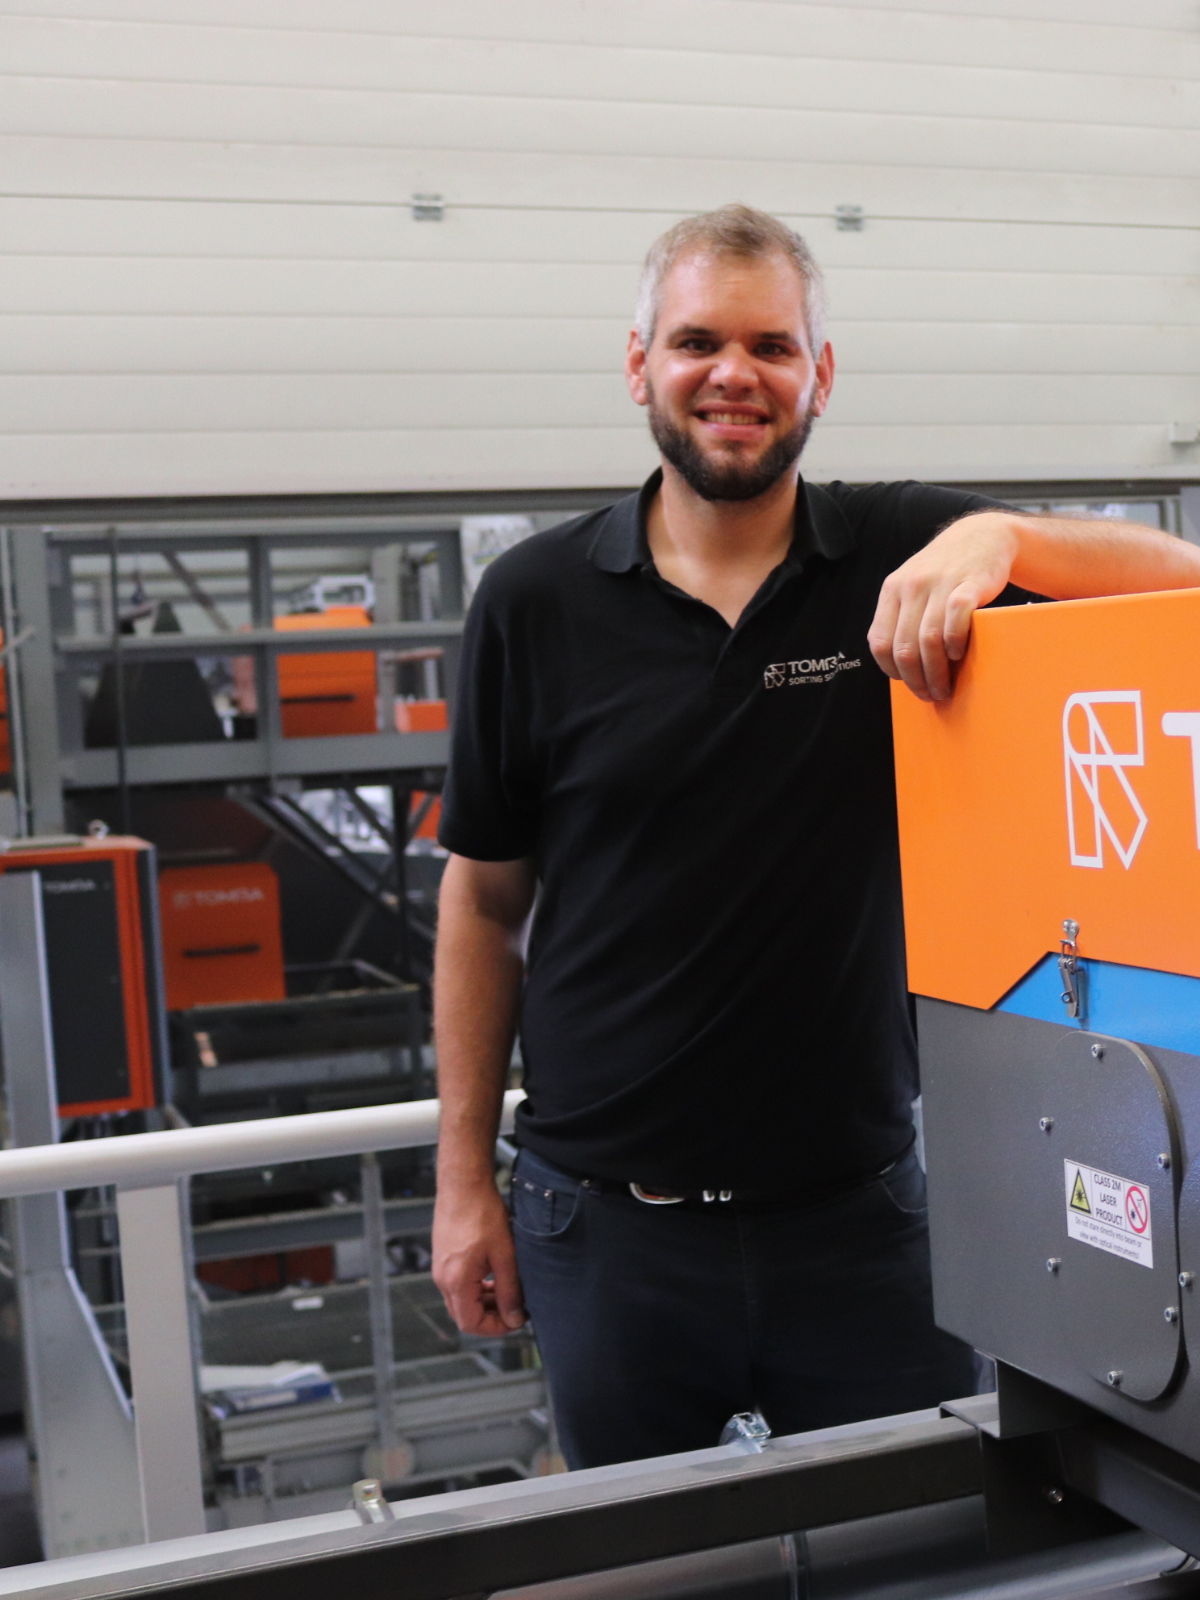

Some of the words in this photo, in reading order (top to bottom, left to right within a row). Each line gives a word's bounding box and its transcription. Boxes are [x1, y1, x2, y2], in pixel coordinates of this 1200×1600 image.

[1094, 1174, 1111, 1188] CLASS
[1100, 1192, 1117, 1208] LASER
[1096, 1207, 1123, 1226] PRODUCT
